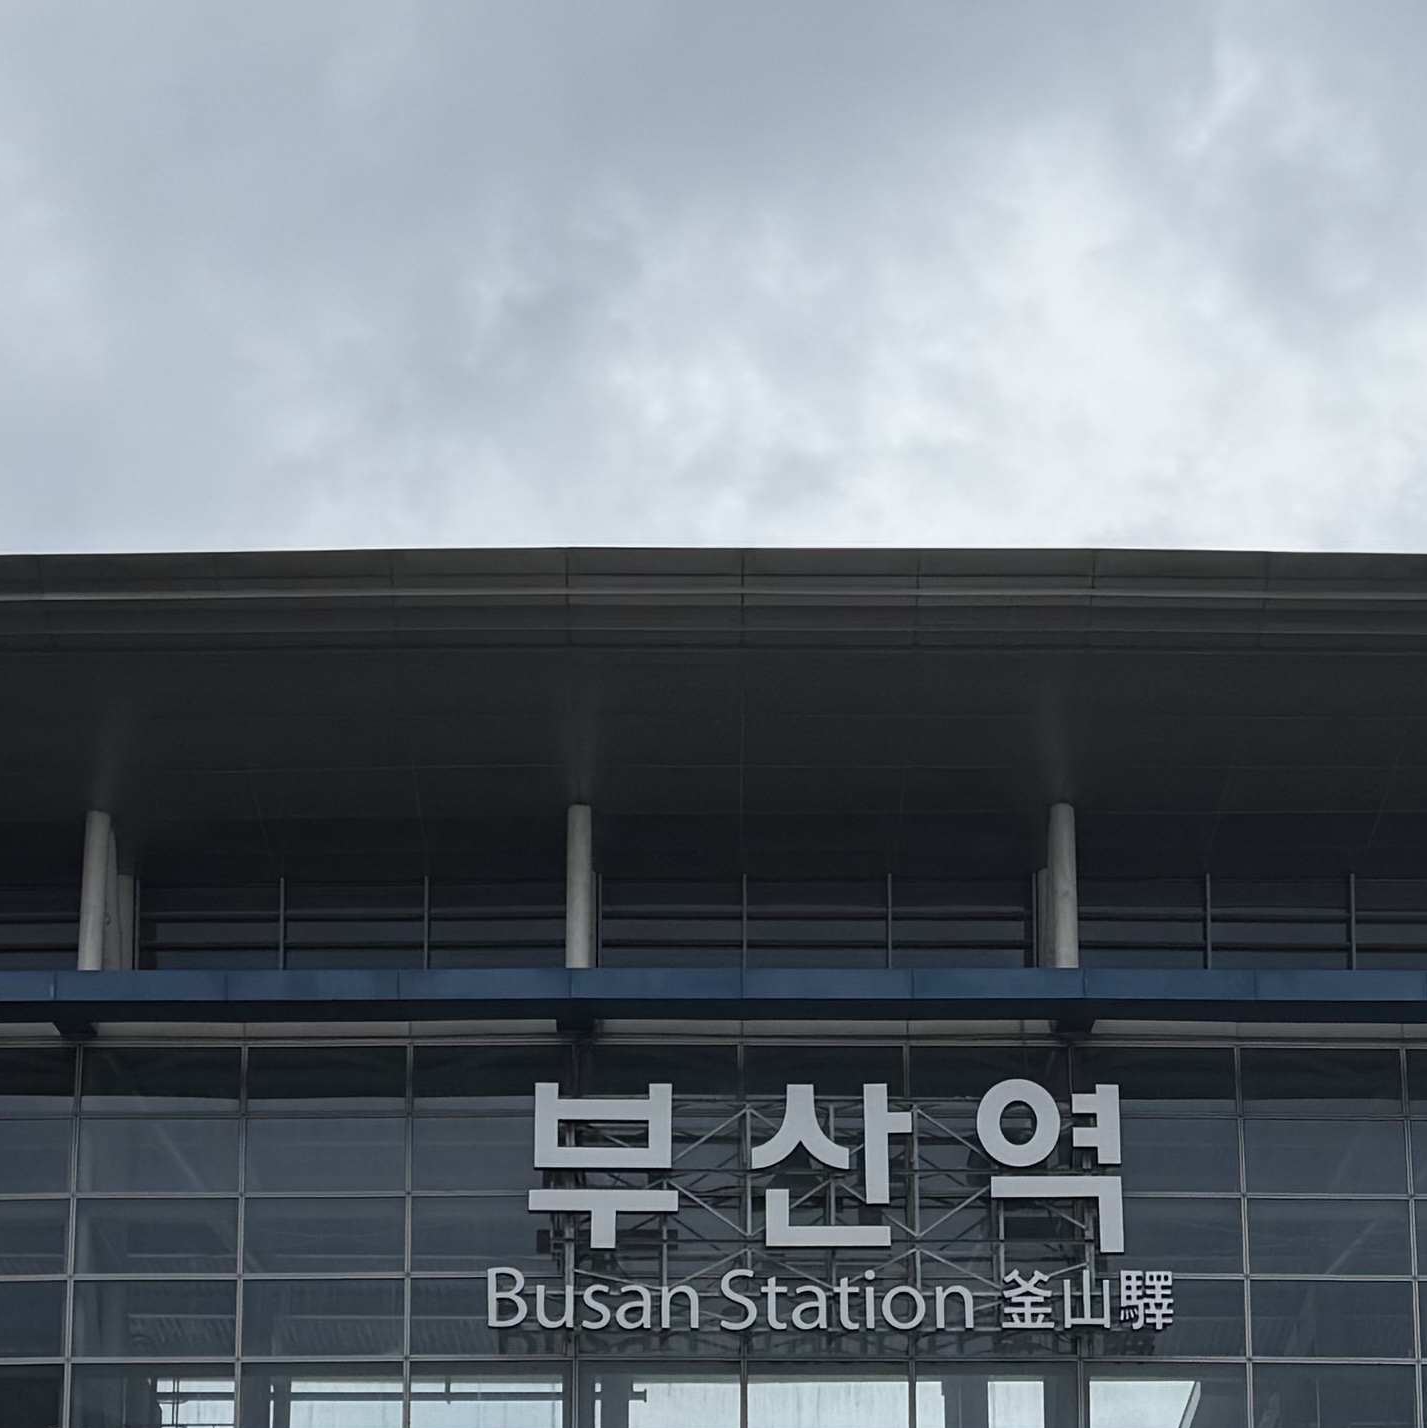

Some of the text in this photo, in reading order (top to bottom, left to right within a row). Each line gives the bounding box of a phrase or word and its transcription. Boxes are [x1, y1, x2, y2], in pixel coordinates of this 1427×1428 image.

[528, 1078, 1125, 1254] 부산역
[486, 1267, 1174, 1331] Busan Station 釜山驛
